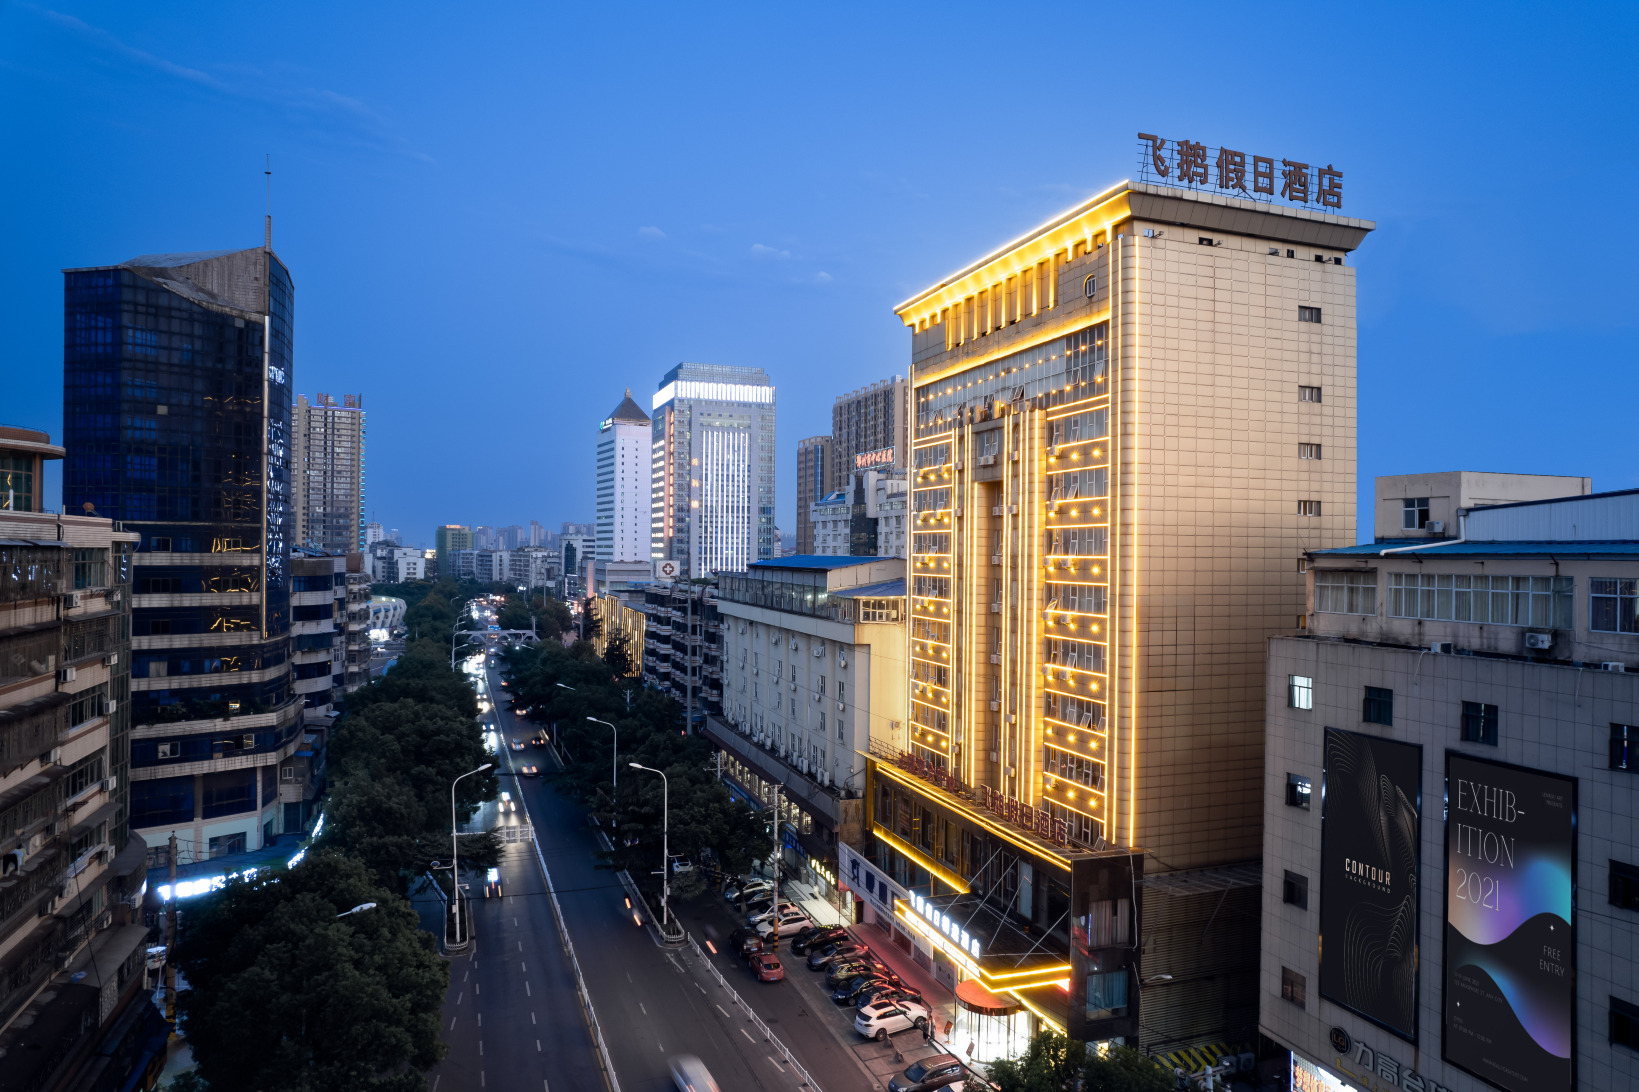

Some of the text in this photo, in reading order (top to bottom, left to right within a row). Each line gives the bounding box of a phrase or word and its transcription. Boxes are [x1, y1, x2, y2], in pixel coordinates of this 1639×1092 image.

[1138, 132, 1343, 208] 飞鹅假日酒店
[981, 783, 1068, 848] 飞鹅假日酒店
[1457, 779, 1525, 823] EXHIB-
[1457, 823, 1515, 870] ITION
[1345, 857, 1391, 886] CONTOUR
[1456, 868, 1500, 912] 2021
[1539, 959, 1565, 977] ENTRY
[1543, 945, 1561, 961] FREE
[1333, 1034, 1346, 1047] LG
